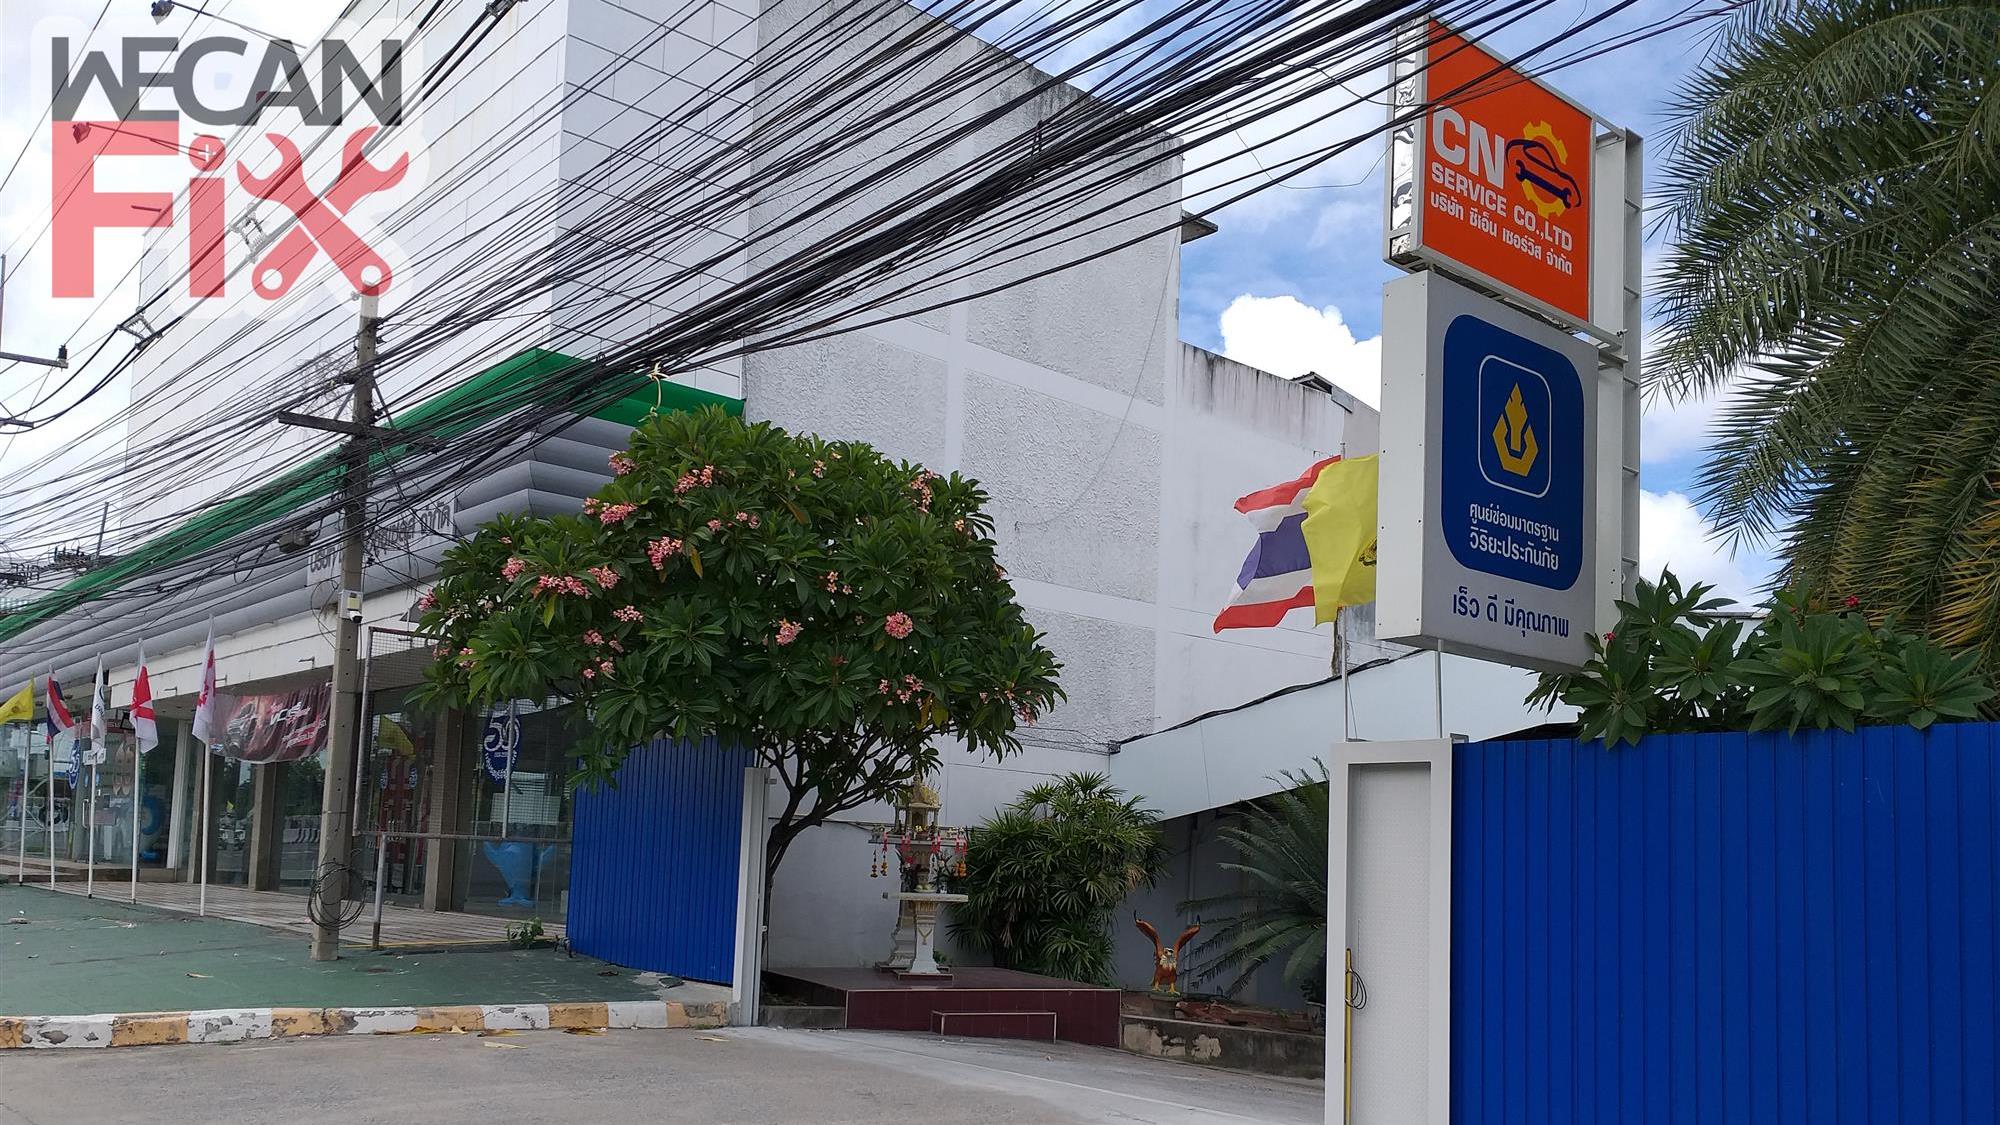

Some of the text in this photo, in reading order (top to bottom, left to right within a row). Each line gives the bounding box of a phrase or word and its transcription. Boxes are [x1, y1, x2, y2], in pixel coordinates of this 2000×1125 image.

[1432, 105, 1506, 190] CN
[1431, 161, 1507, 217] SERVICE
[1430, 191, 1464, 220] บริษัท
[1546, 247, 1573, 276] จำกัด
[1469, 502, 1560, 543] ศูนย์ซ่อมมาตรฐาน
[1469, 525, 1559, 571] วิริยะประกันภัย
[1452, 585, 1569, 638] เร็ว ดี มีคุณภาพ
